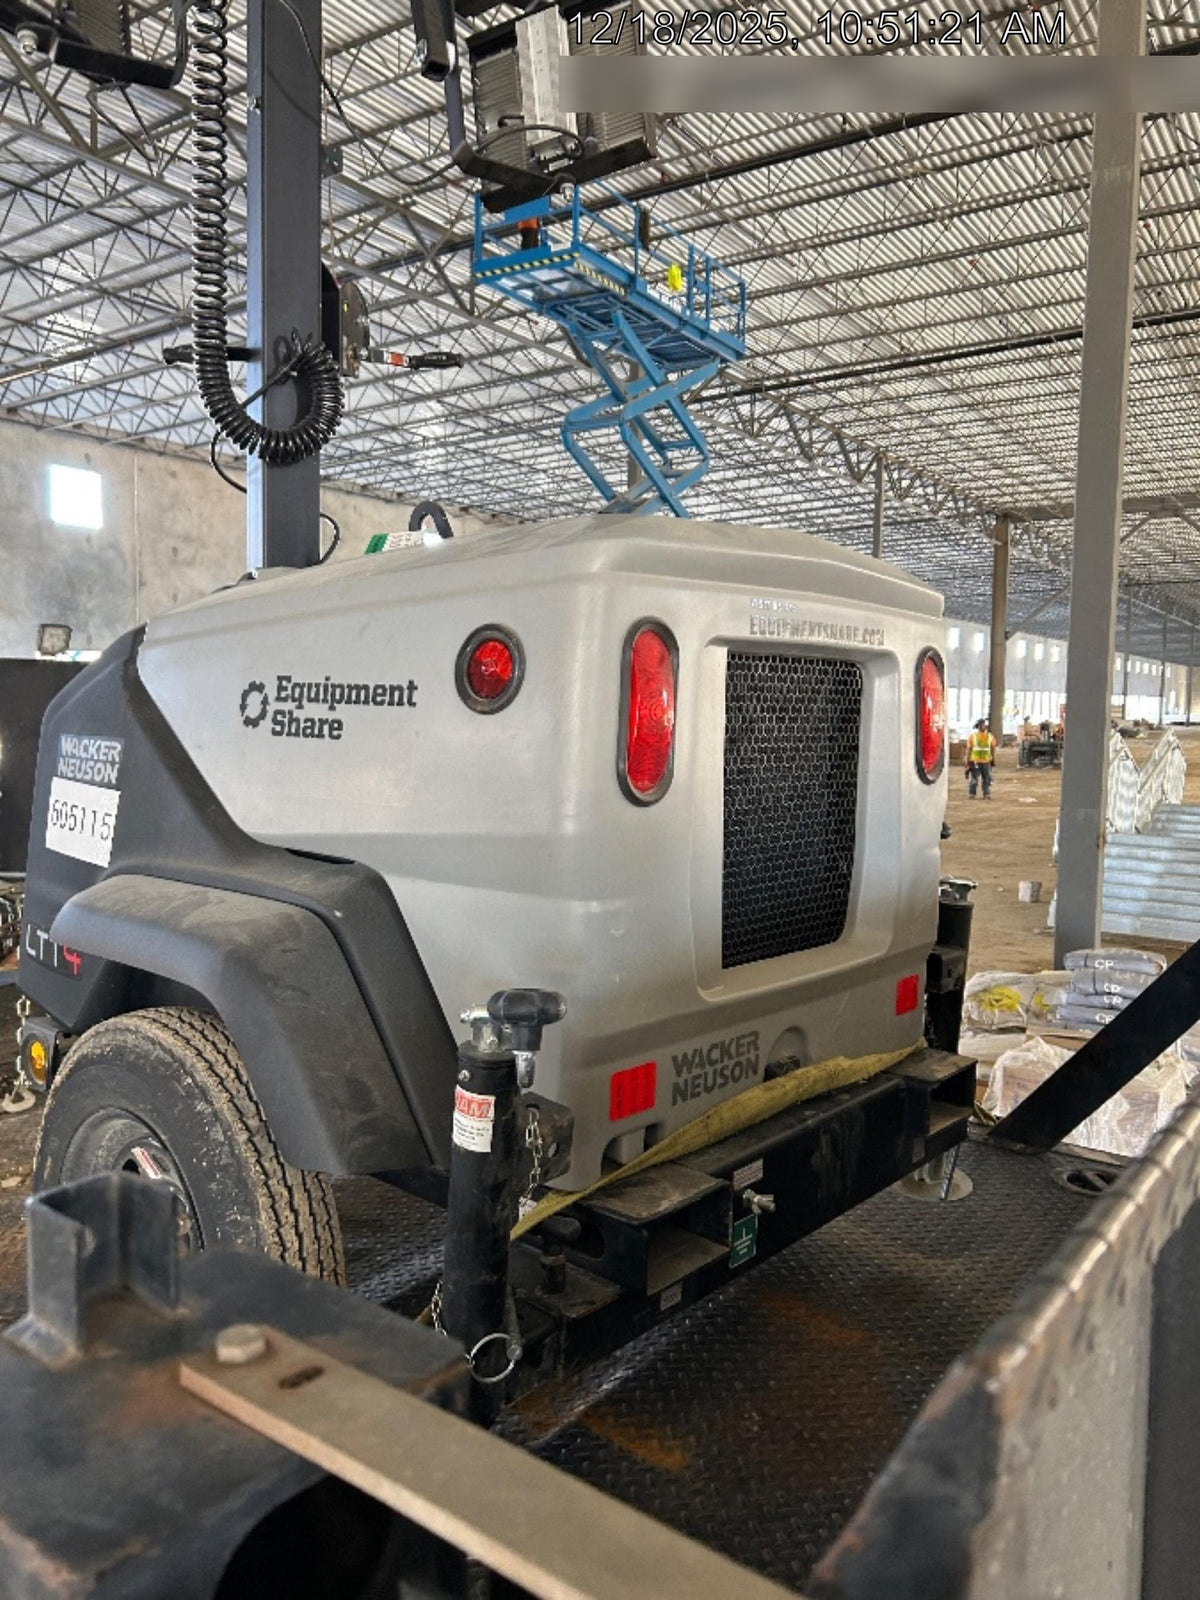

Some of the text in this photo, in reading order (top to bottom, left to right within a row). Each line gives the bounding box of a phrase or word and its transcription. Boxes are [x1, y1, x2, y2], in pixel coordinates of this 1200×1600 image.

[275, 675, 418, 711] Equipment
[271, 709, 344, 740] Share
[61, 735, 121, 762] WACKER
[58, 757, 120, 784] NEUSON
[51, 799, 112, 841] 605115
[672, 1030, 760, 1078] WACKER
[672, 1053, 760, 1106] NEUSON
